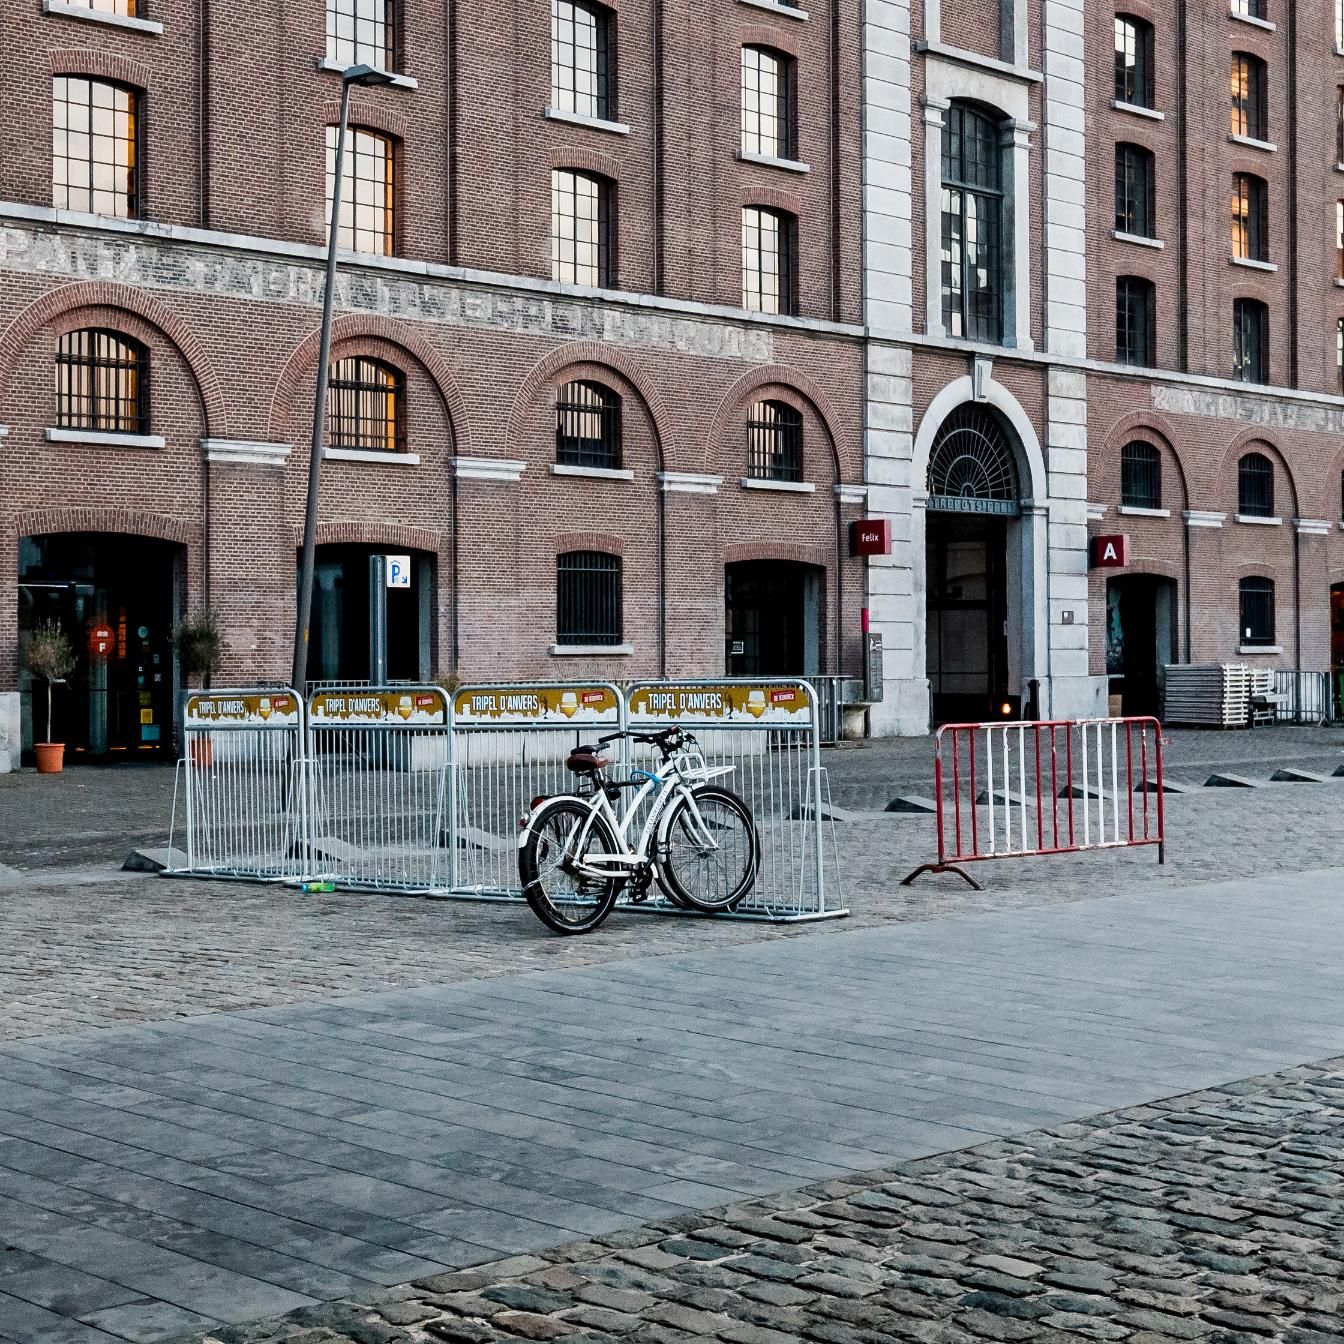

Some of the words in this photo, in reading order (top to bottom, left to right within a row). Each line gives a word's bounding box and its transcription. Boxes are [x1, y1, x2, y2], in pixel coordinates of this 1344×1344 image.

[861, 533, 879, 543] Felix
[1103, 542, 1118, 560] A
[391, 565, 401, 584] P
[198, 701, 216, 714] TRIPEL
[325, 698, 346, 712] TRIPEL
[471, 695, 498, 710] TRIPEL
[500, 694, 538, 710] D'ANVERS
[648, 693, 677, 709] TRIPEL
[680, 692, 722, 709] D'ANVERS
